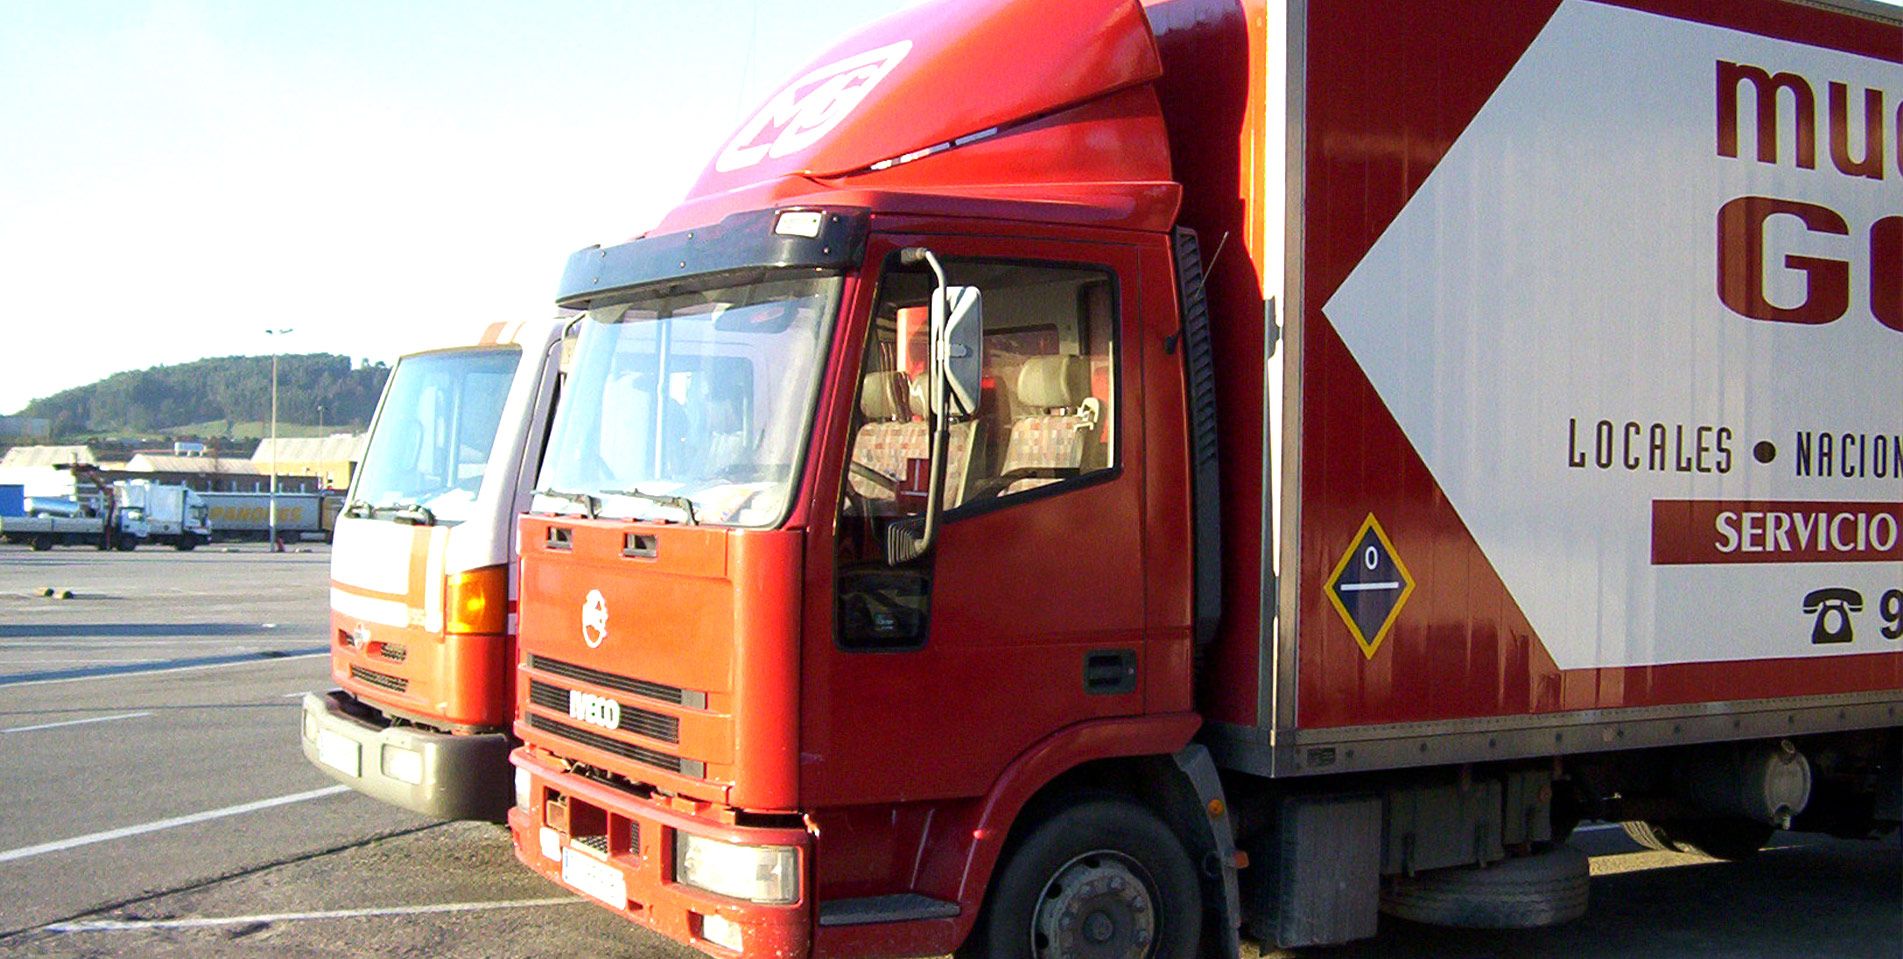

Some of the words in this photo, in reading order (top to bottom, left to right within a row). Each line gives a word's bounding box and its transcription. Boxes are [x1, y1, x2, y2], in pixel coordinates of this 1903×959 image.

[1716, 59, 1903, 181] mu
[1568, 418, 1732, 474] LOCALES
[1714, 511, 1898, 553] SERVICIO
[569, 690, 621, 730] IVECO
